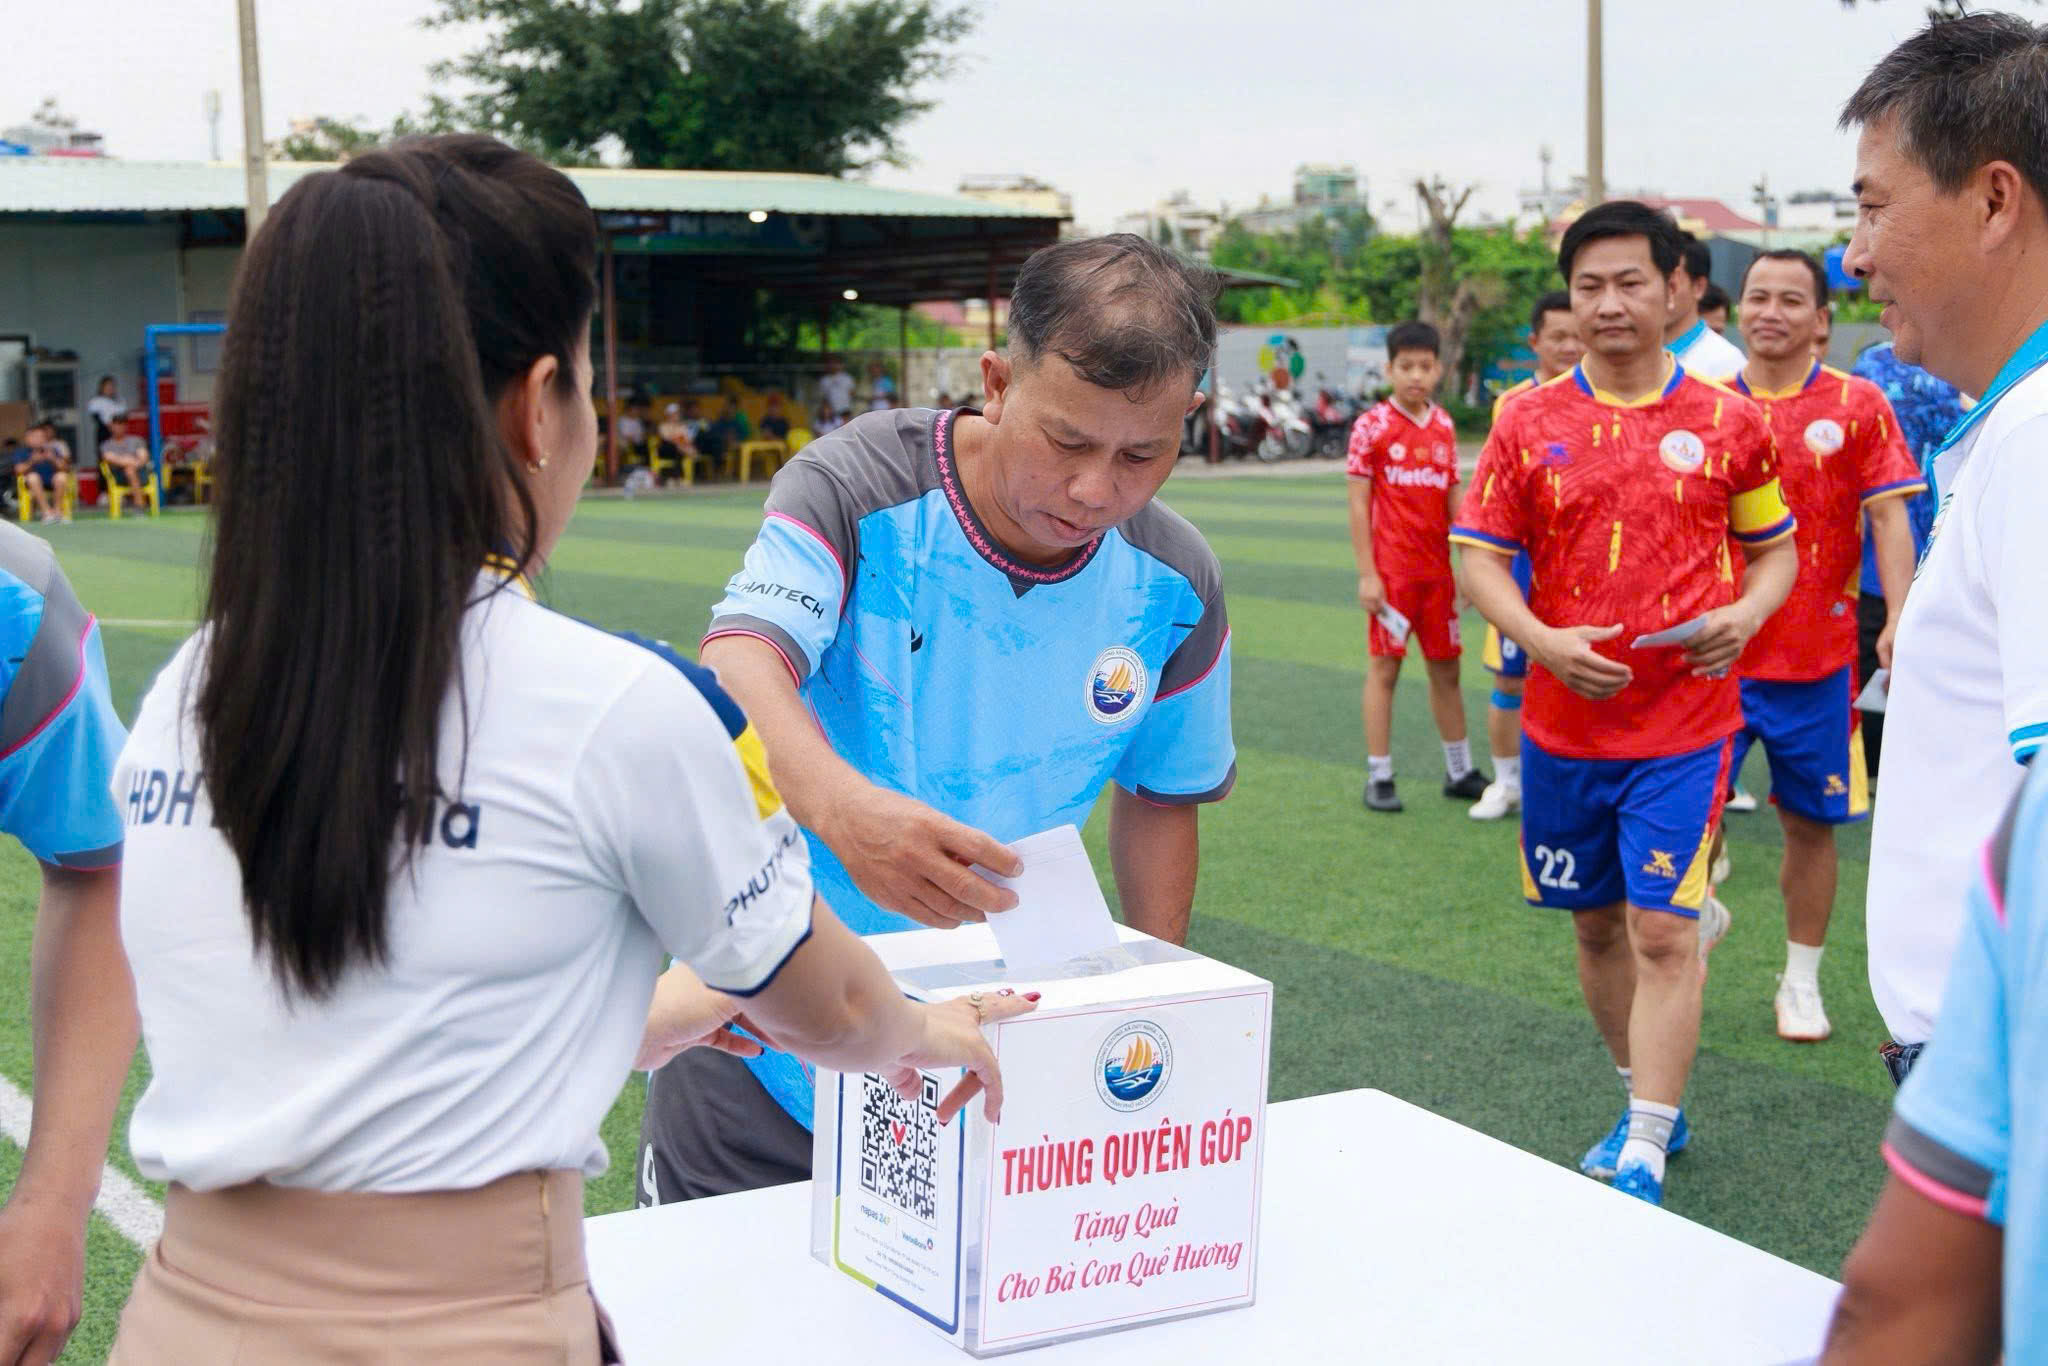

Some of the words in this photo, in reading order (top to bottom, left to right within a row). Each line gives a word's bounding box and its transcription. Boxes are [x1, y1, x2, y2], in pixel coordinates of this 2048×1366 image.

[1535, 844, 1580, 890] 22
[1002, 1134, 1094, 1196] THÙNG
[1103, 1117, 1192, 1185] QUYÊN
[1200, 1108, 1252, 1167] GÓP
[1073, 1211, 1130, 1247] Tặng
[1134, 1197, 1179, 1238] Quà
[998, 1272, 1040, 1303] Cho
[1045, 1262, 1076, 1295] Bà
[1081, 1259, 1122, 1288] Con
[1126, 1247, 1171, 1287] Quê
[1172, 1241, 1243, 1272] Hương
